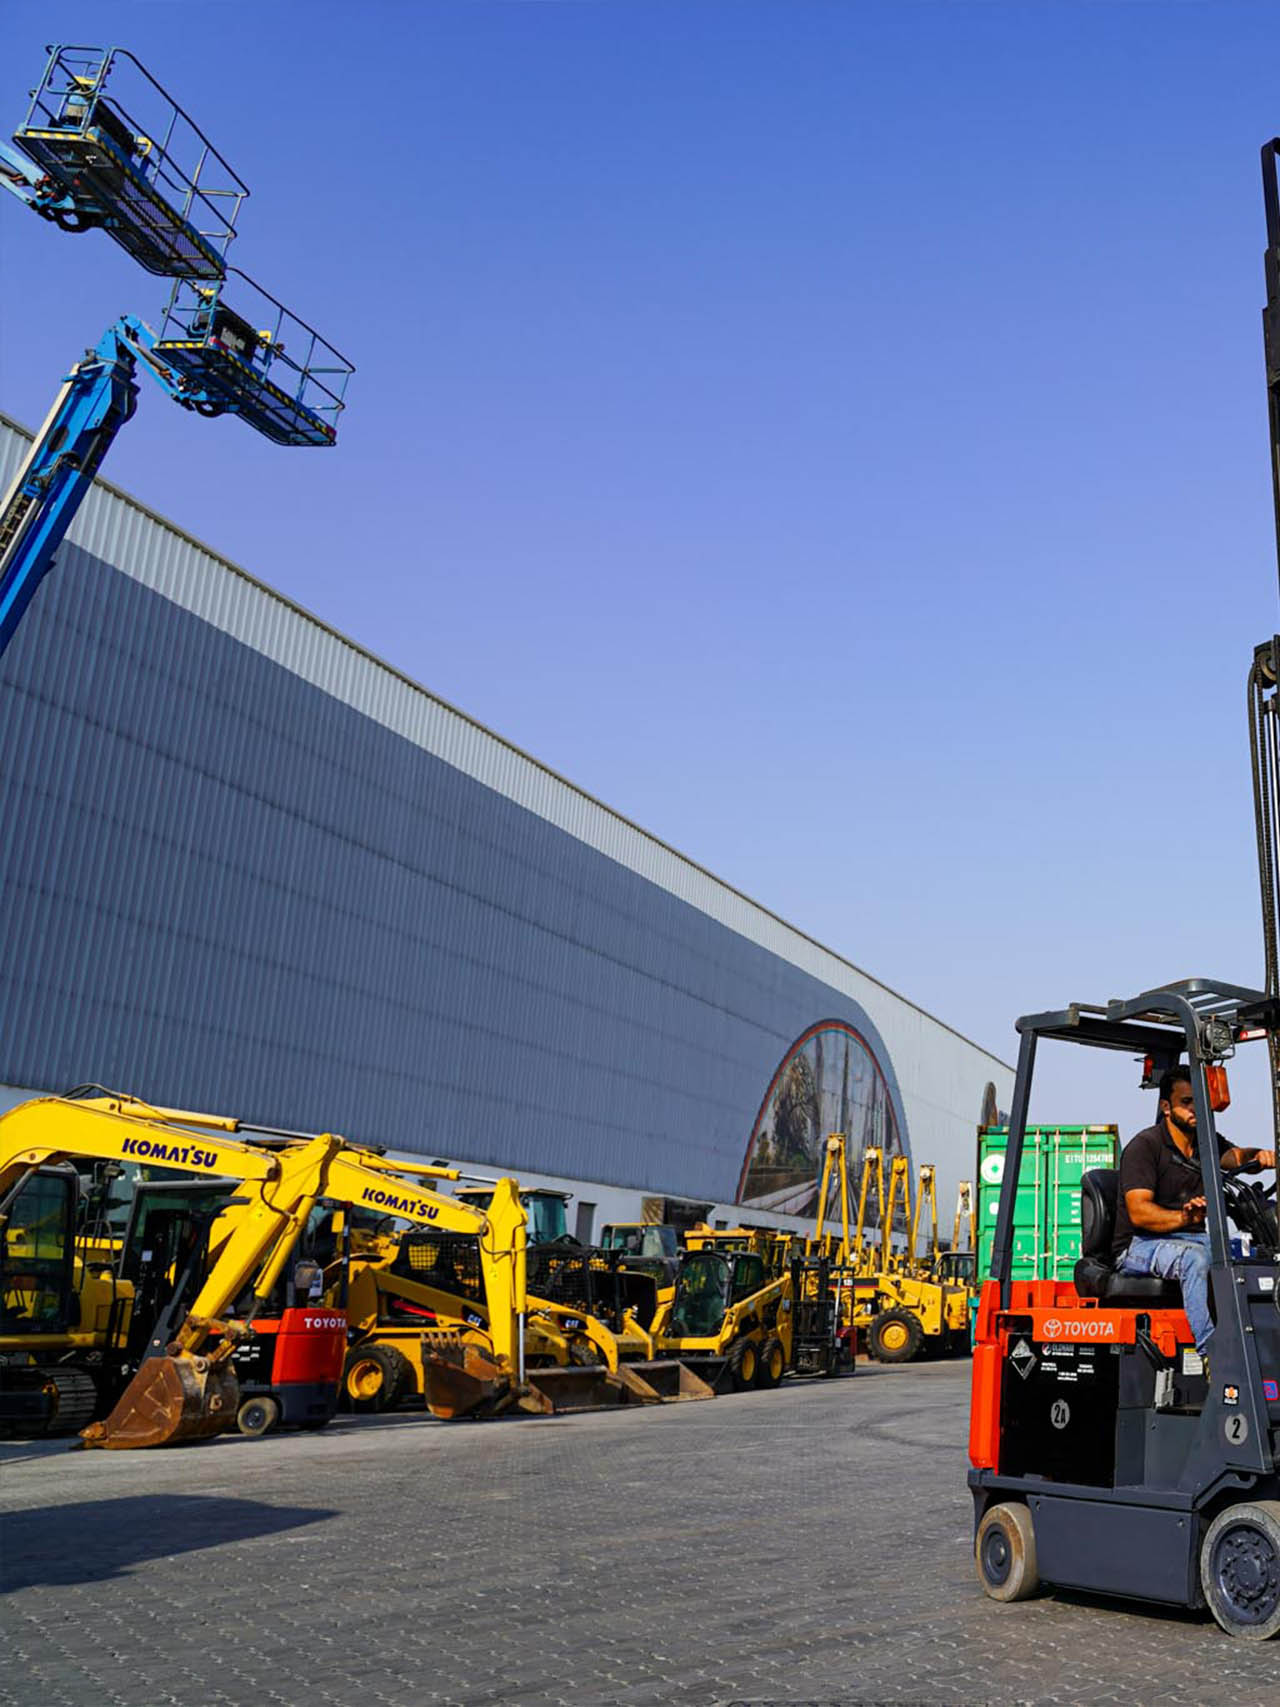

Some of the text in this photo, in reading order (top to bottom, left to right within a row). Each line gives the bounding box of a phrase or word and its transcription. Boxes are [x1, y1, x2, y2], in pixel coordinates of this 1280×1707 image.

[122, 1137, 218, 1168] KOMATSU
[362, 1187, 439, 1219] KOMATSU
[304, 1317, 346, 1328] TOYOTA
[1064, 1321, 1114, 1336] TOYOTA
[1054, 1404, 1066, 1424] 2A
[1232, 1418, 1241, 1438] 2
